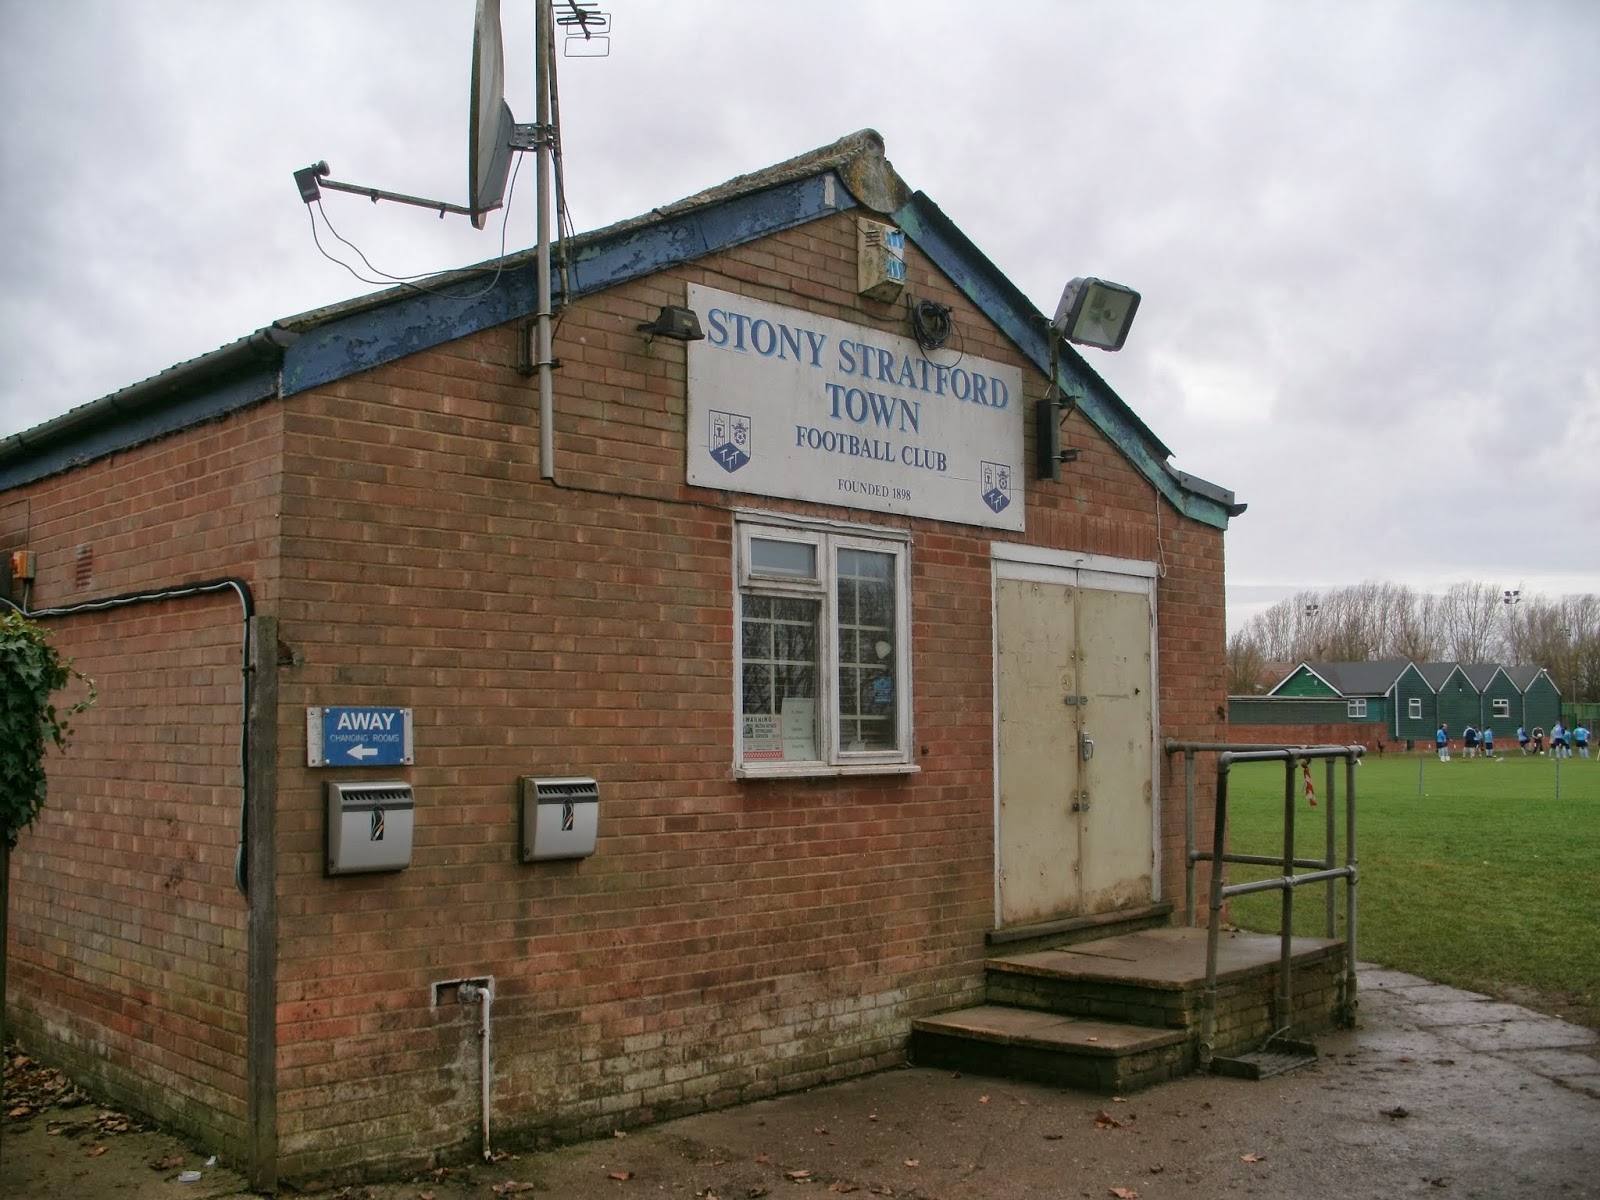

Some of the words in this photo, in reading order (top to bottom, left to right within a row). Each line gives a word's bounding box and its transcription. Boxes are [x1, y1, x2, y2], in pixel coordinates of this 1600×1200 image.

[707, 308, 828, 369] STONY
[838, 339, 1009, 410] STRATFORD
[825, 382, 921, 435] TOWN
[795, 425, 896, 463] FOOTBALL
[901, 445, 948, 472] CLUB
[837, 478, 890, 498] FOUNDED
[892, 487, 912, 501] 1898
[329, 734, 369, 743] CHANGING
[372, 734, 400, 743] ROOMS
[337, 712, 395, 731] AWAY
